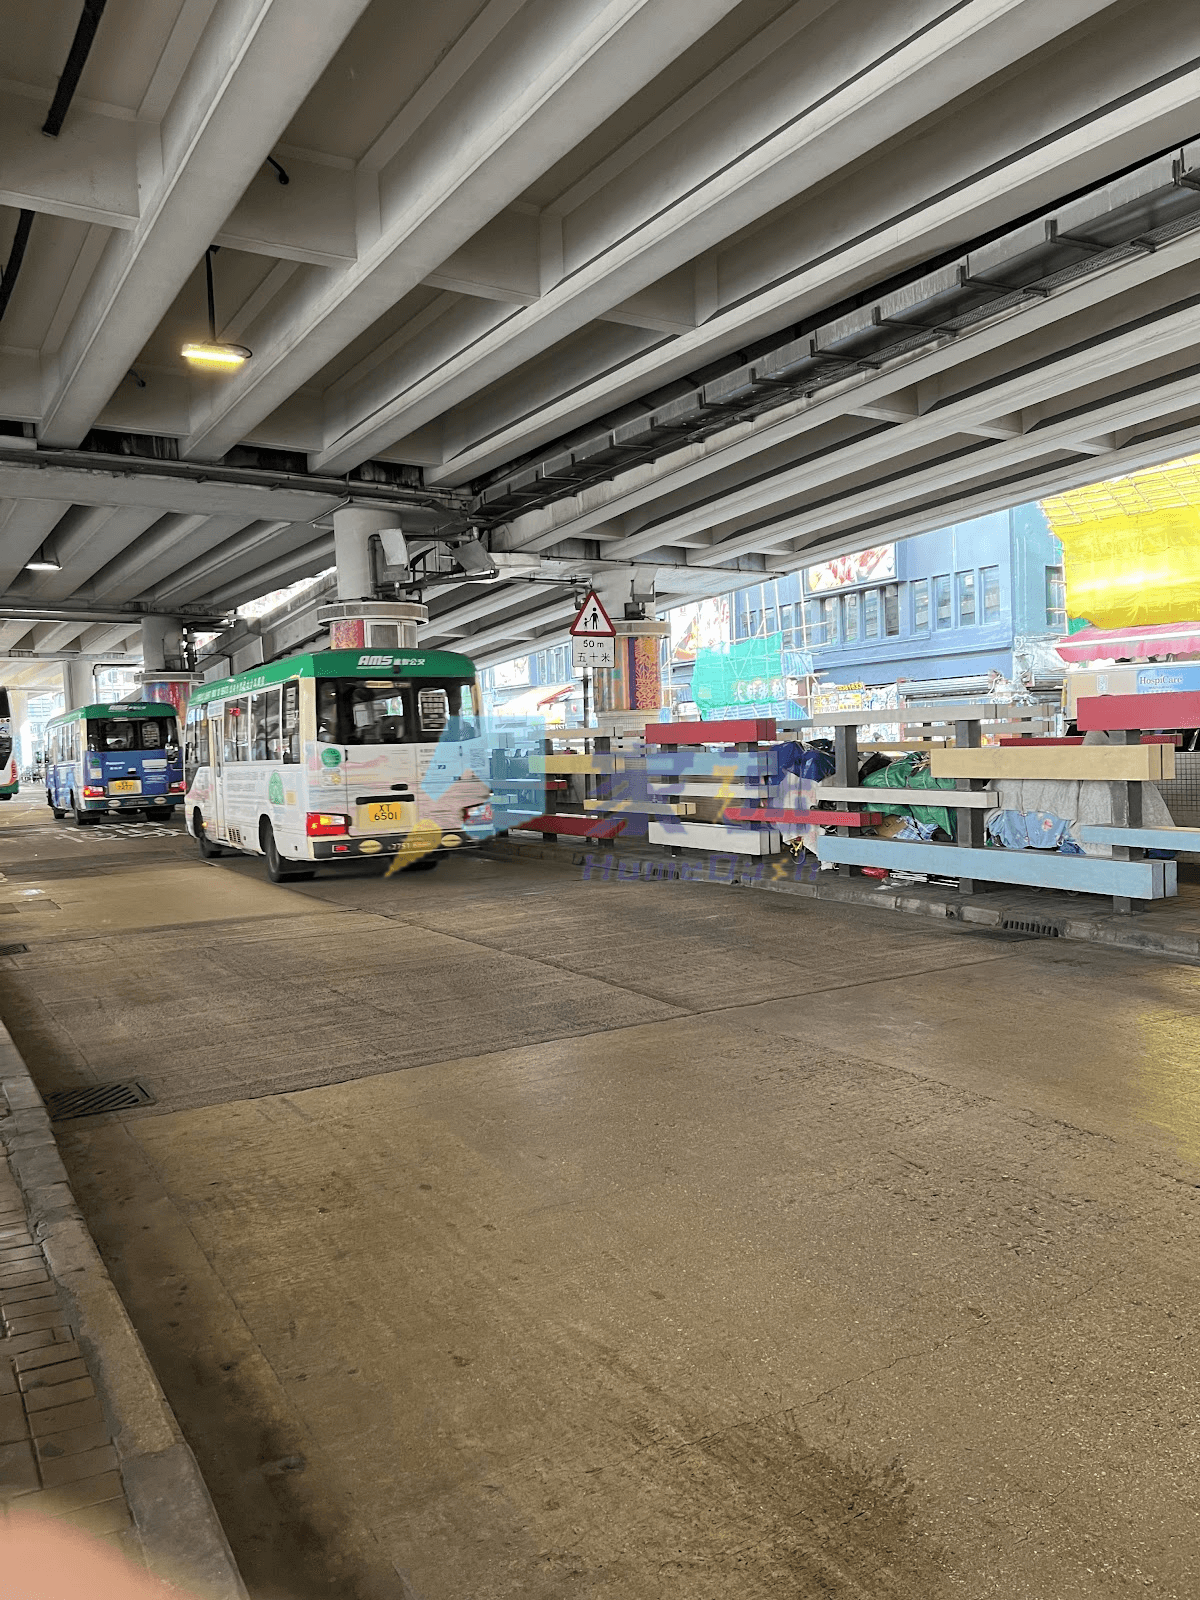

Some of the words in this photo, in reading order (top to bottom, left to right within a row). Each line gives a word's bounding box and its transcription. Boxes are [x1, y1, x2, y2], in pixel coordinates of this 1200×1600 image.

[583, 639, 595, 648] 50
[357, 655, 393, 666] AMS
[577, 652, 611, 663] 五十米
[1140, 675, 1182, 685] HospiCare
[379, 804, 391, 812] XT
[374, 811, 398, 821] 6501
